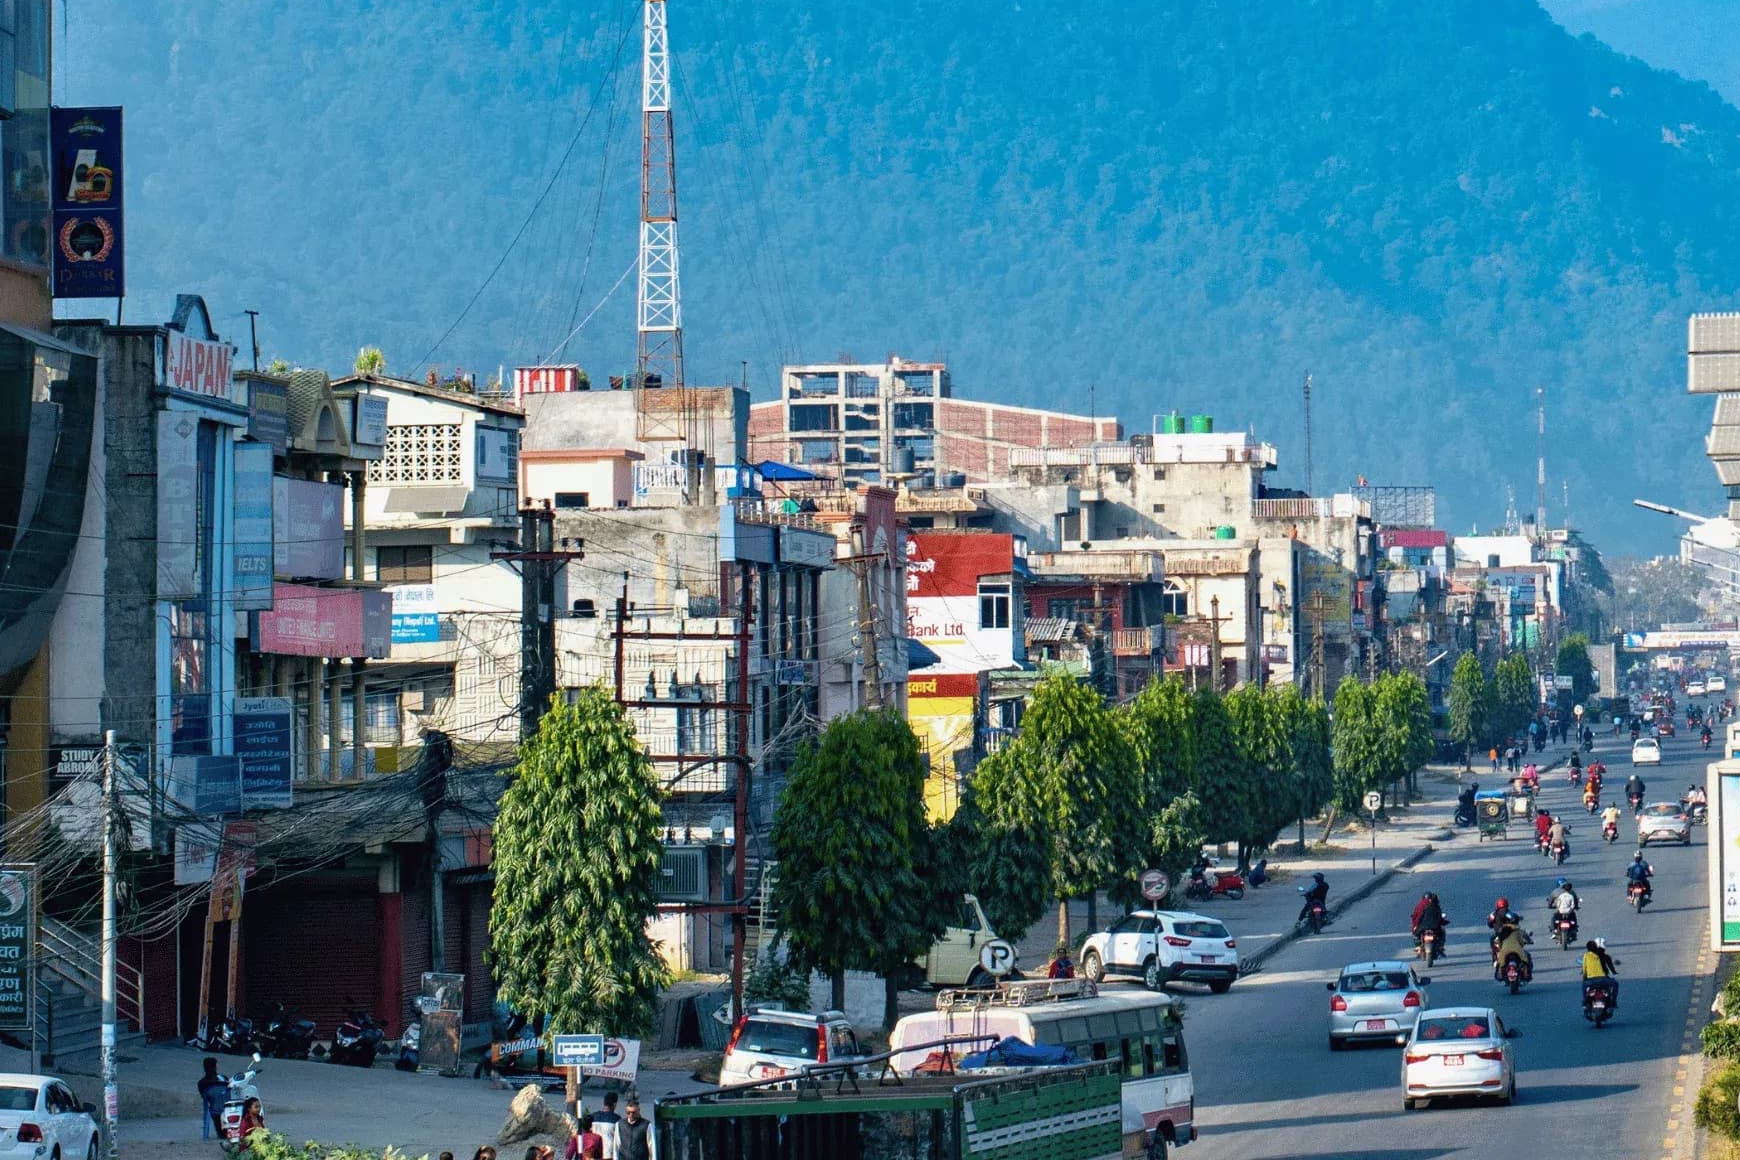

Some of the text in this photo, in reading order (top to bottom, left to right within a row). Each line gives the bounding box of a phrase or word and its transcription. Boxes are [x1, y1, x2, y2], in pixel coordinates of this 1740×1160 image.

[174, 339, 229, 396] JAPAN
[237, 556, 267, 572] IELTS
[944, 622, 966, 636] Ltd.
[61, 749, 95, 762] STUDY
[988, 946, 1009, 969] P
[595, 1068, 635, 1079] PARKING
